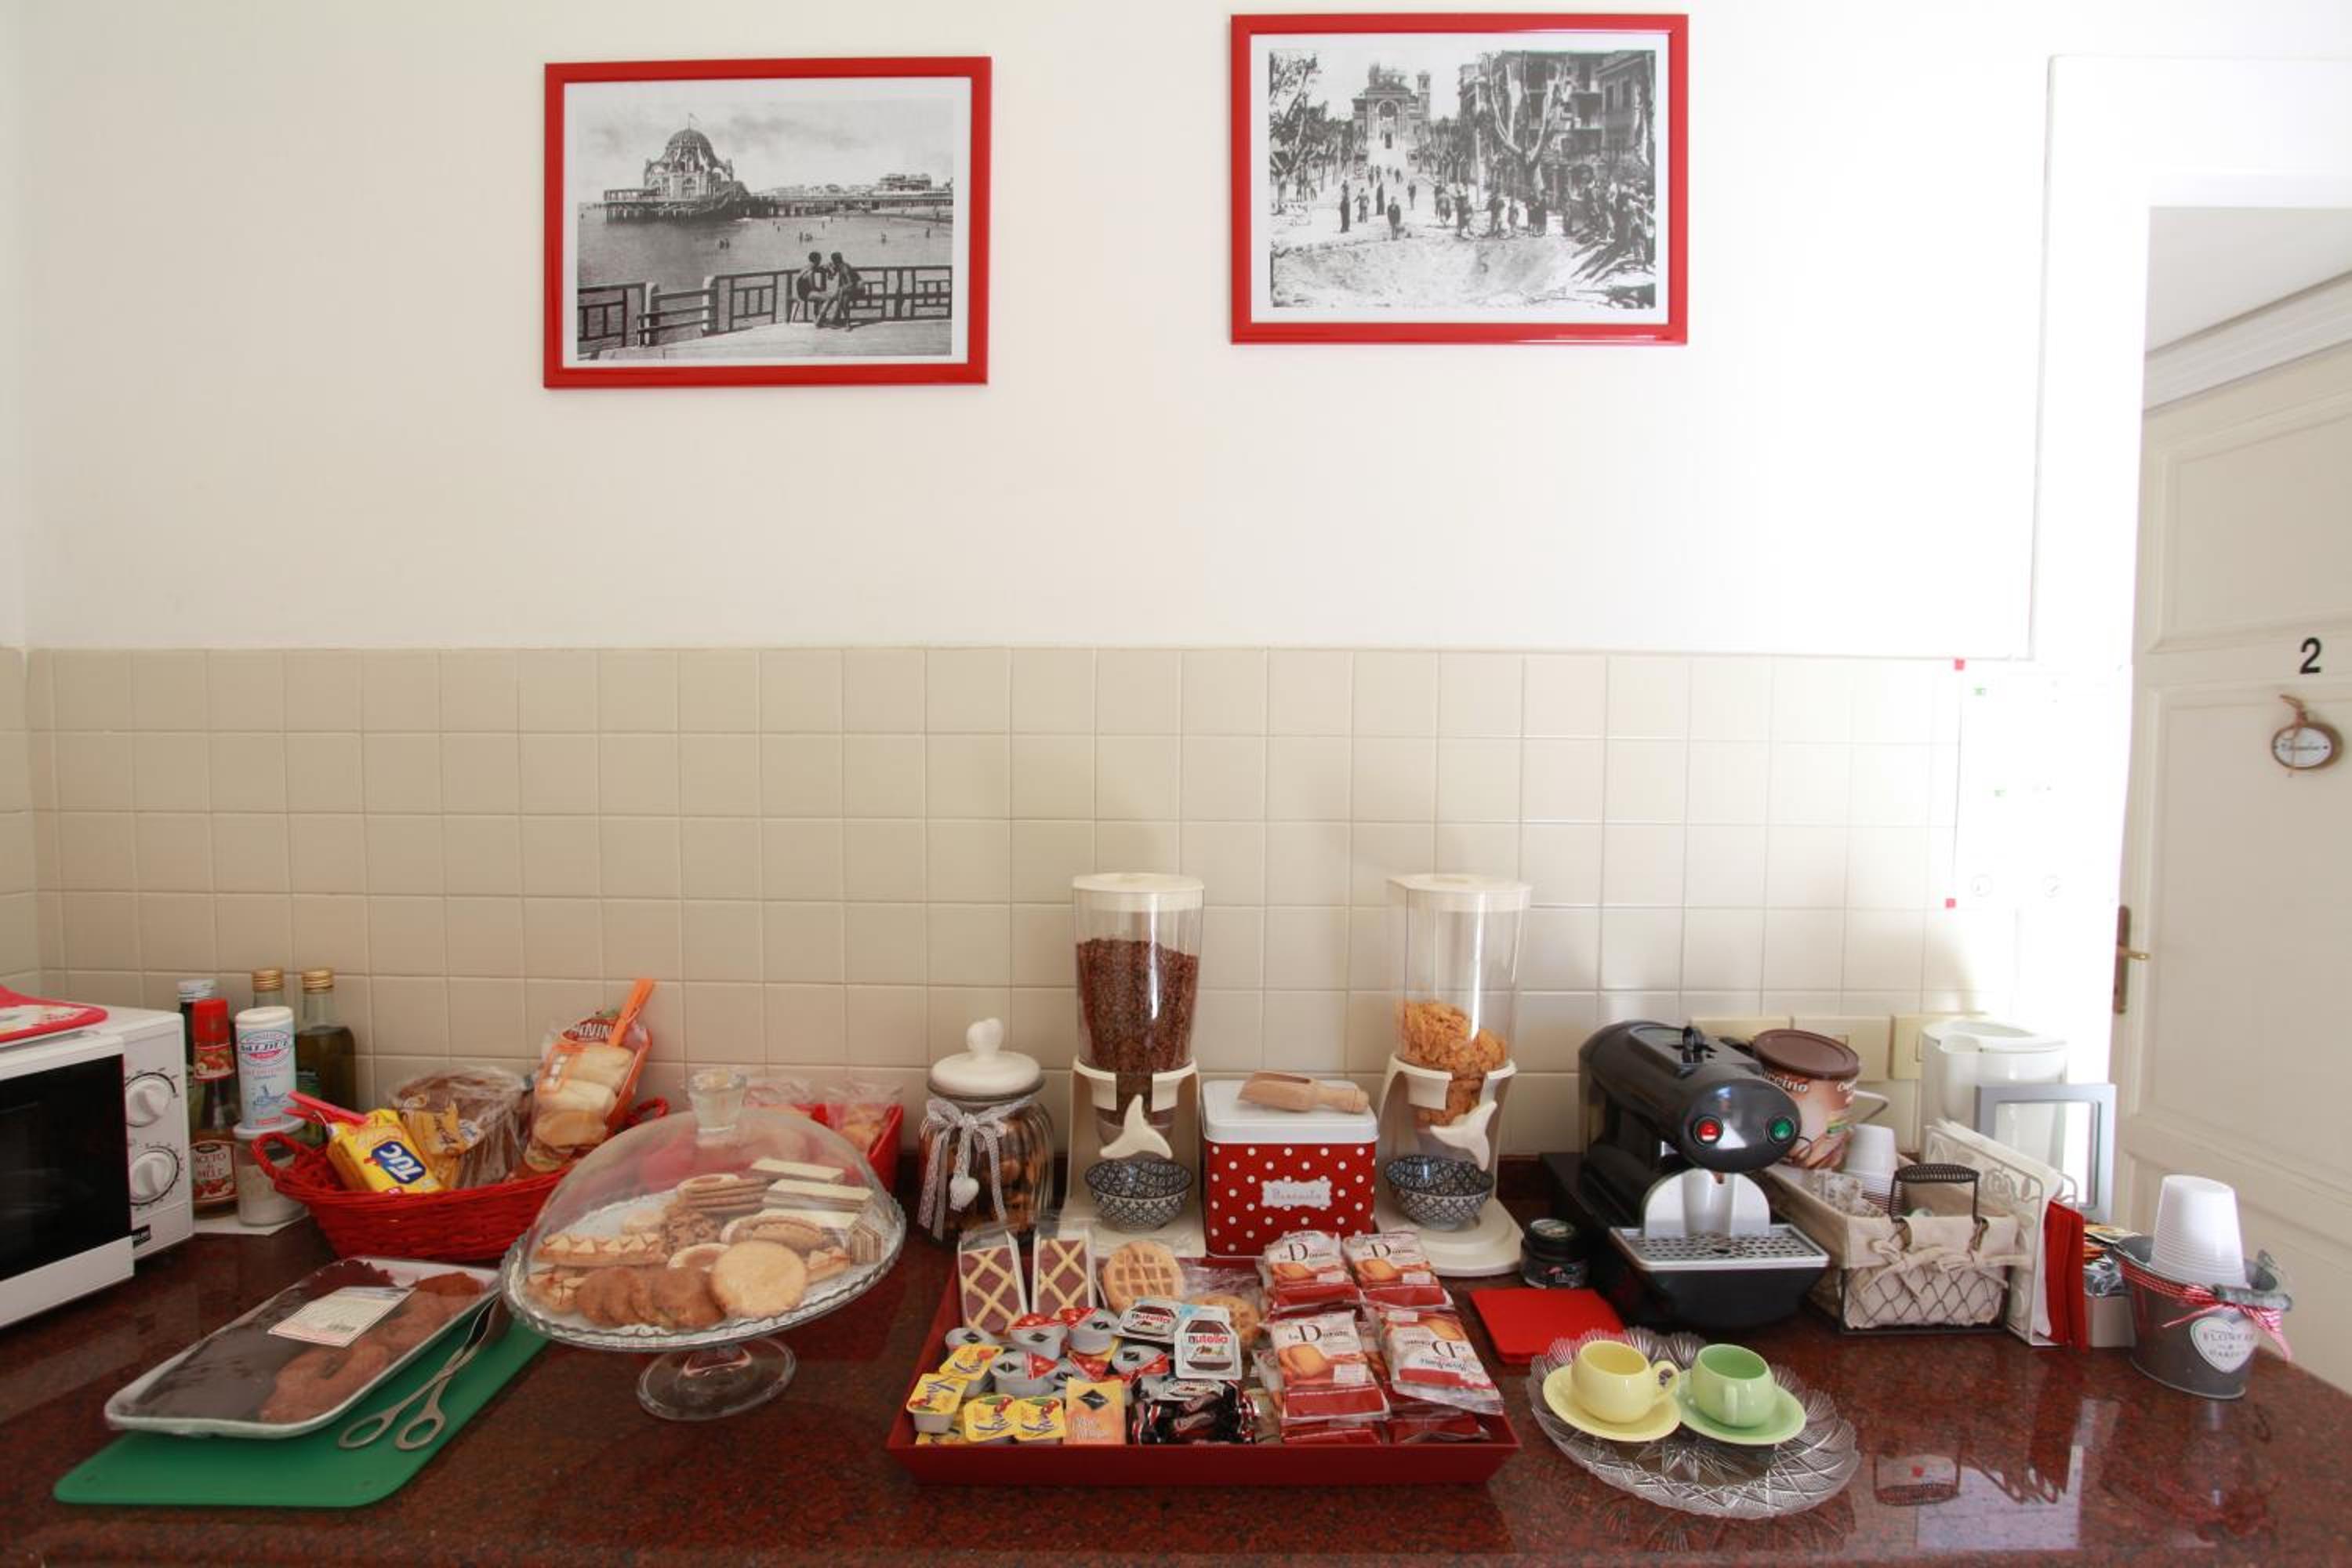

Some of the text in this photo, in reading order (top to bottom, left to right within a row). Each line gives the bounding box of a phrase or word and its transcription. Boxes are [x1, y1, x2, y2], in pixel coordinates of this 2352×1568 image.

[2299, 637, 2321, 674] 2
[379, 1144, 423, 1181] TUC
[1131, 1312, 1171, 1324] nutella
[1187, 1334, 1229, 1344] nutella
